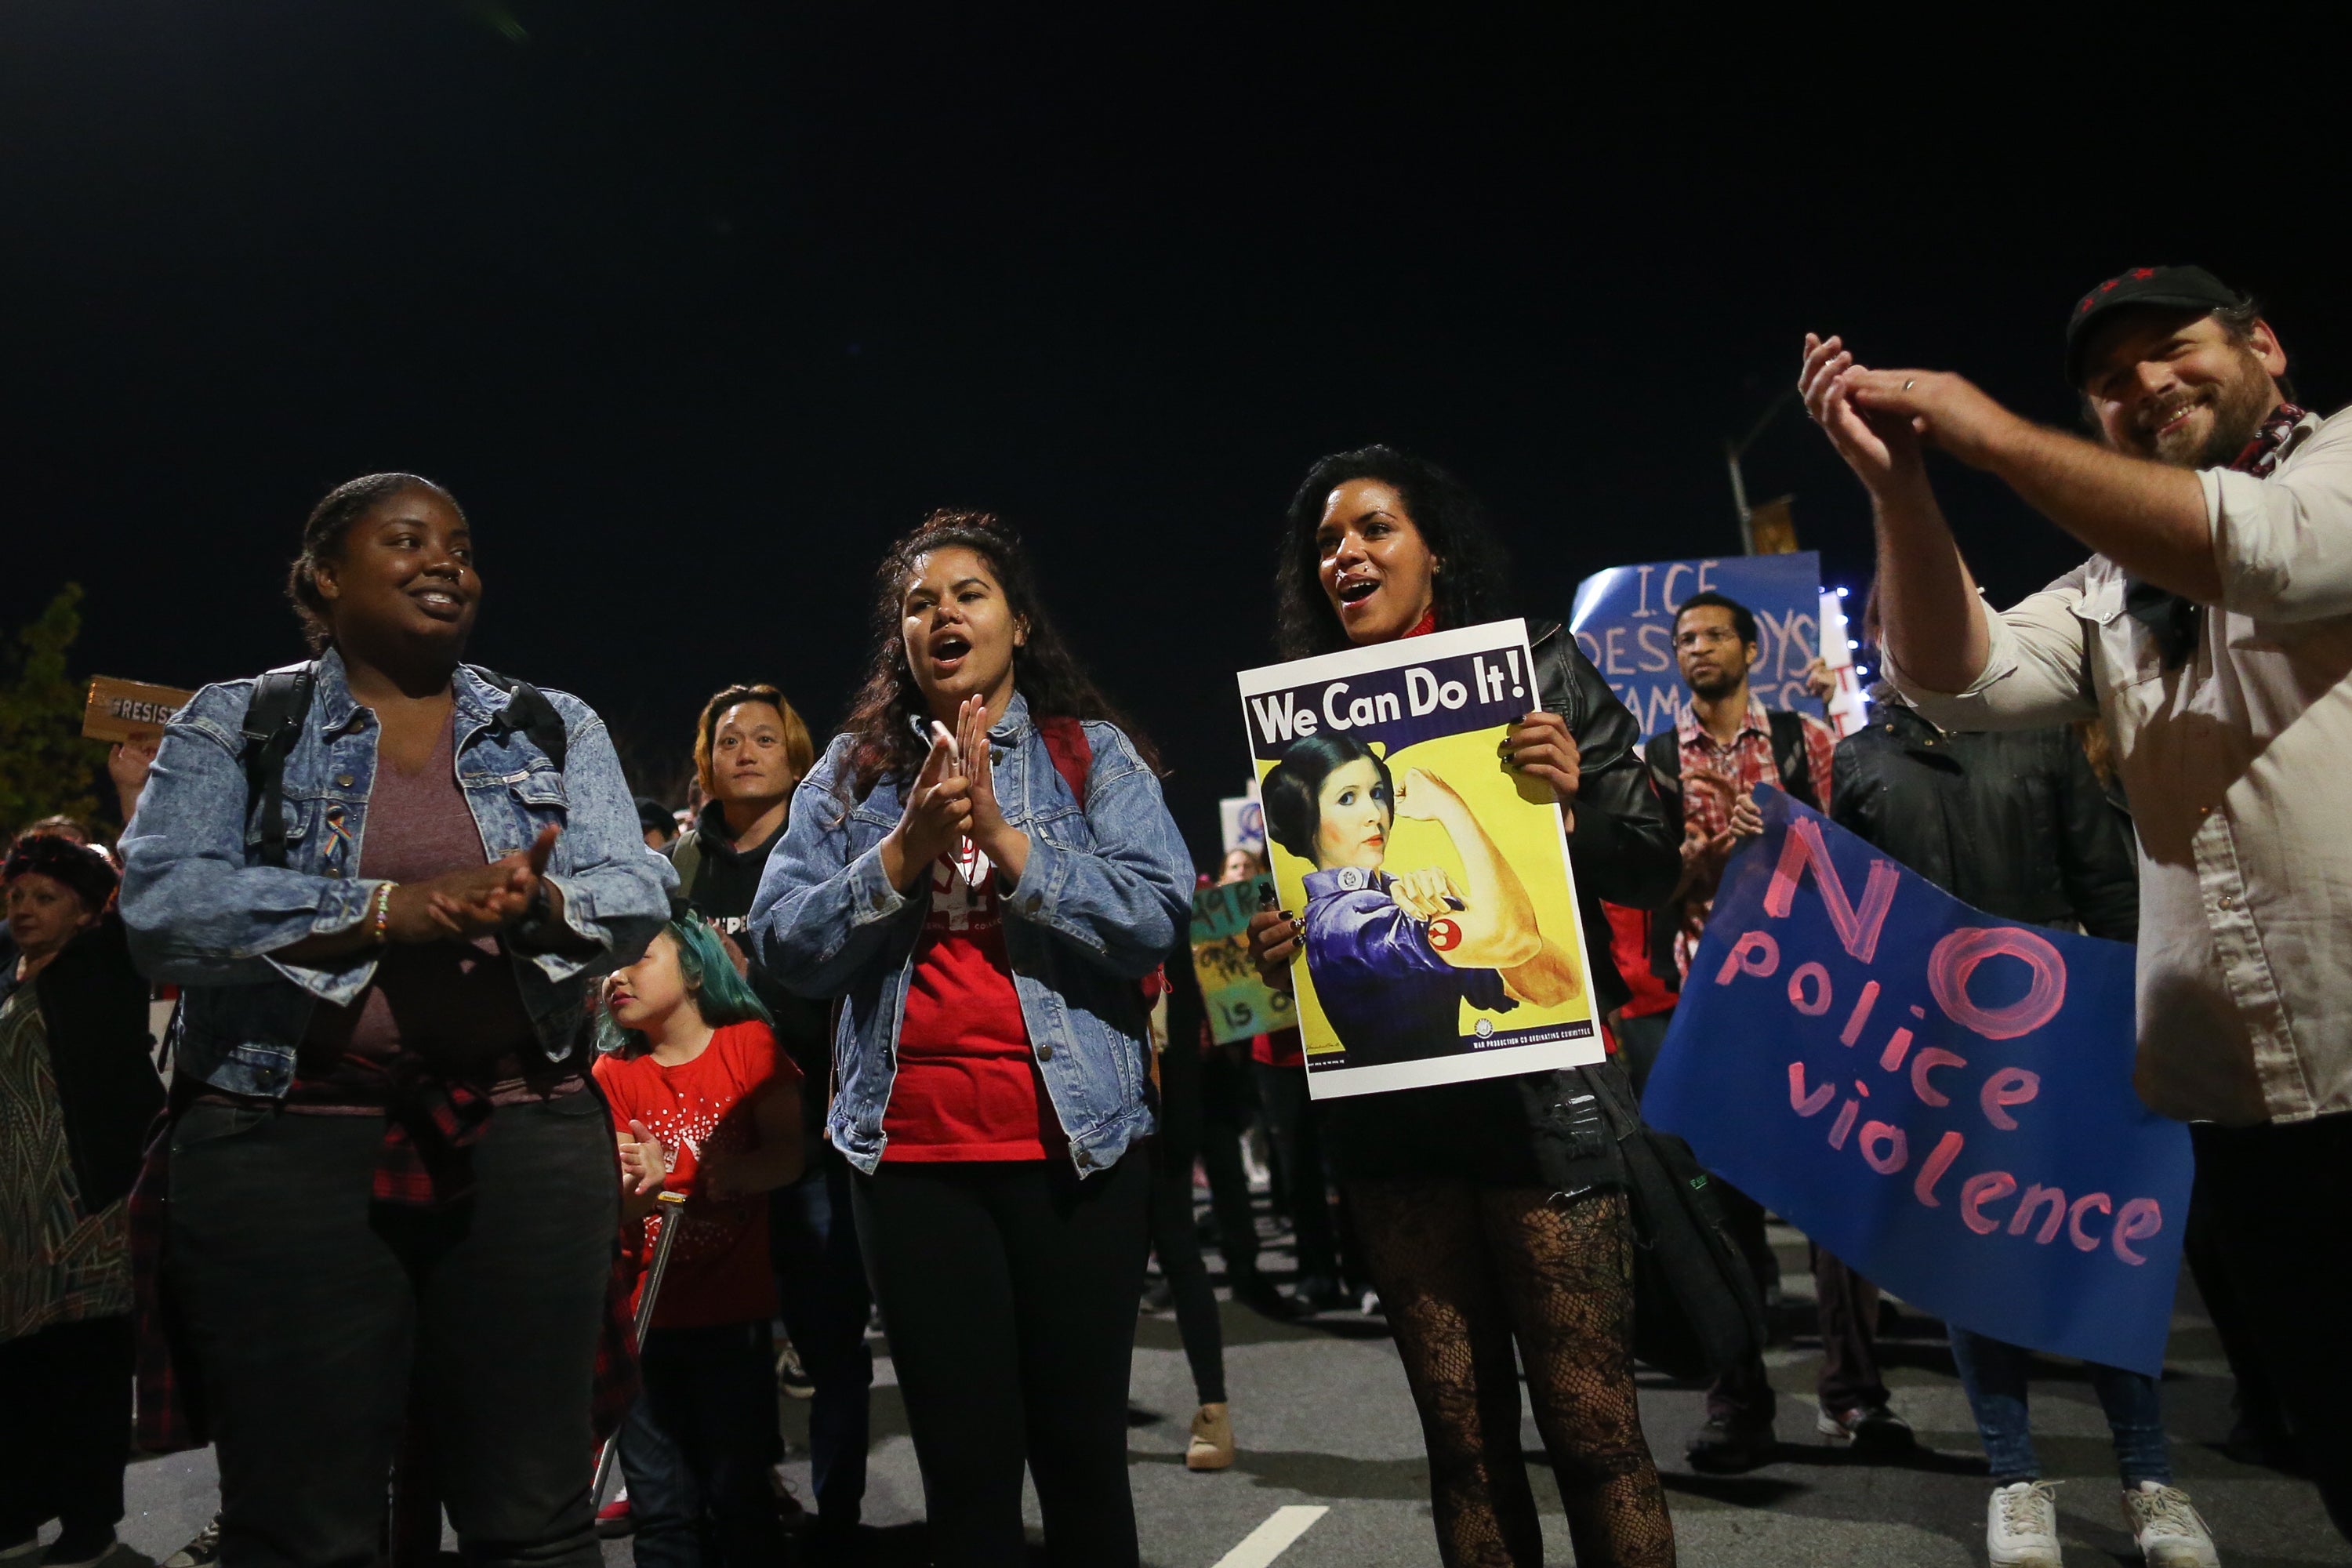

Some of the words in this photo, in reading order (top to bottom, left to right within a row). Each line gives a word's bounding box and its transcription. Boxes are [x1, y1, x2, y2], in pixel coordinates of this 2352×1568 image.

[1251, 692, 1318, 743] We
[1323, 682, 1401, 730] Can
[1405, 667, 1468, 717] Do
[1473, 650, 1526, 704] It!
[1763, 816, 2067, 1040] NO
[1486, 1037, 1519, 1047] PRODUCTION
[1561, 1028, 1592, 1038] COMMITTEE
[1788, 1062, 2162, 1265] violence
